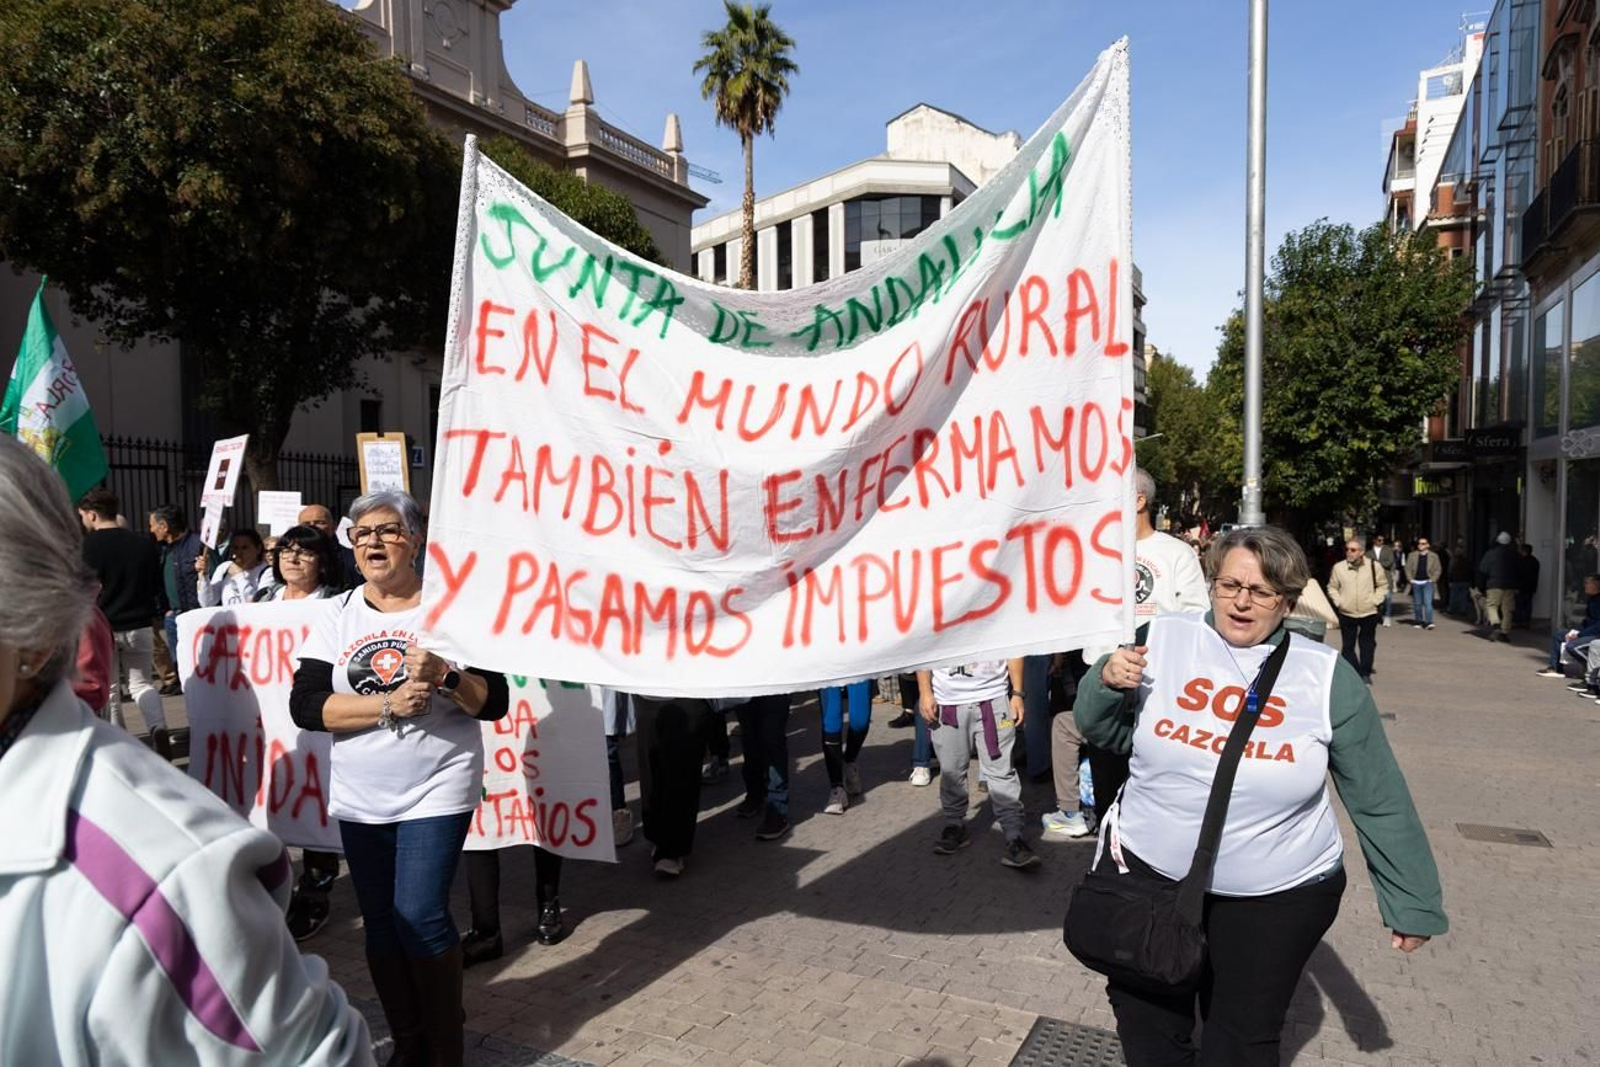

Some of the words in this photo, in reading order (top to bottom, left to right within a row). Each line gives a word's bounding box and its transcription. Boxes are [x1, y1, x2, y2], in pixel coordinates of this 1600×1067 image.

[481, 203, 684, 338] JUNTA
[709, 302, 772, 348] DE
[476, 300, 558, 385] EN
[582, 322, 645, 413] EL
[677, 341, 924, 441] MUNDO
[945, 258, 1129, 385] RURAL
[763, 397, 1133, 543] ENFERMAMOS
[338, 630, 388, 667] CAZORLA
[391, 630, 407, 638] EN
[353, 641, 389, 663] SANIDAD
[422, 542, 477, 632] Y
[492, 552, 752, 660] PAGAMOS
[1176, 677, 1287, 728] SOS
